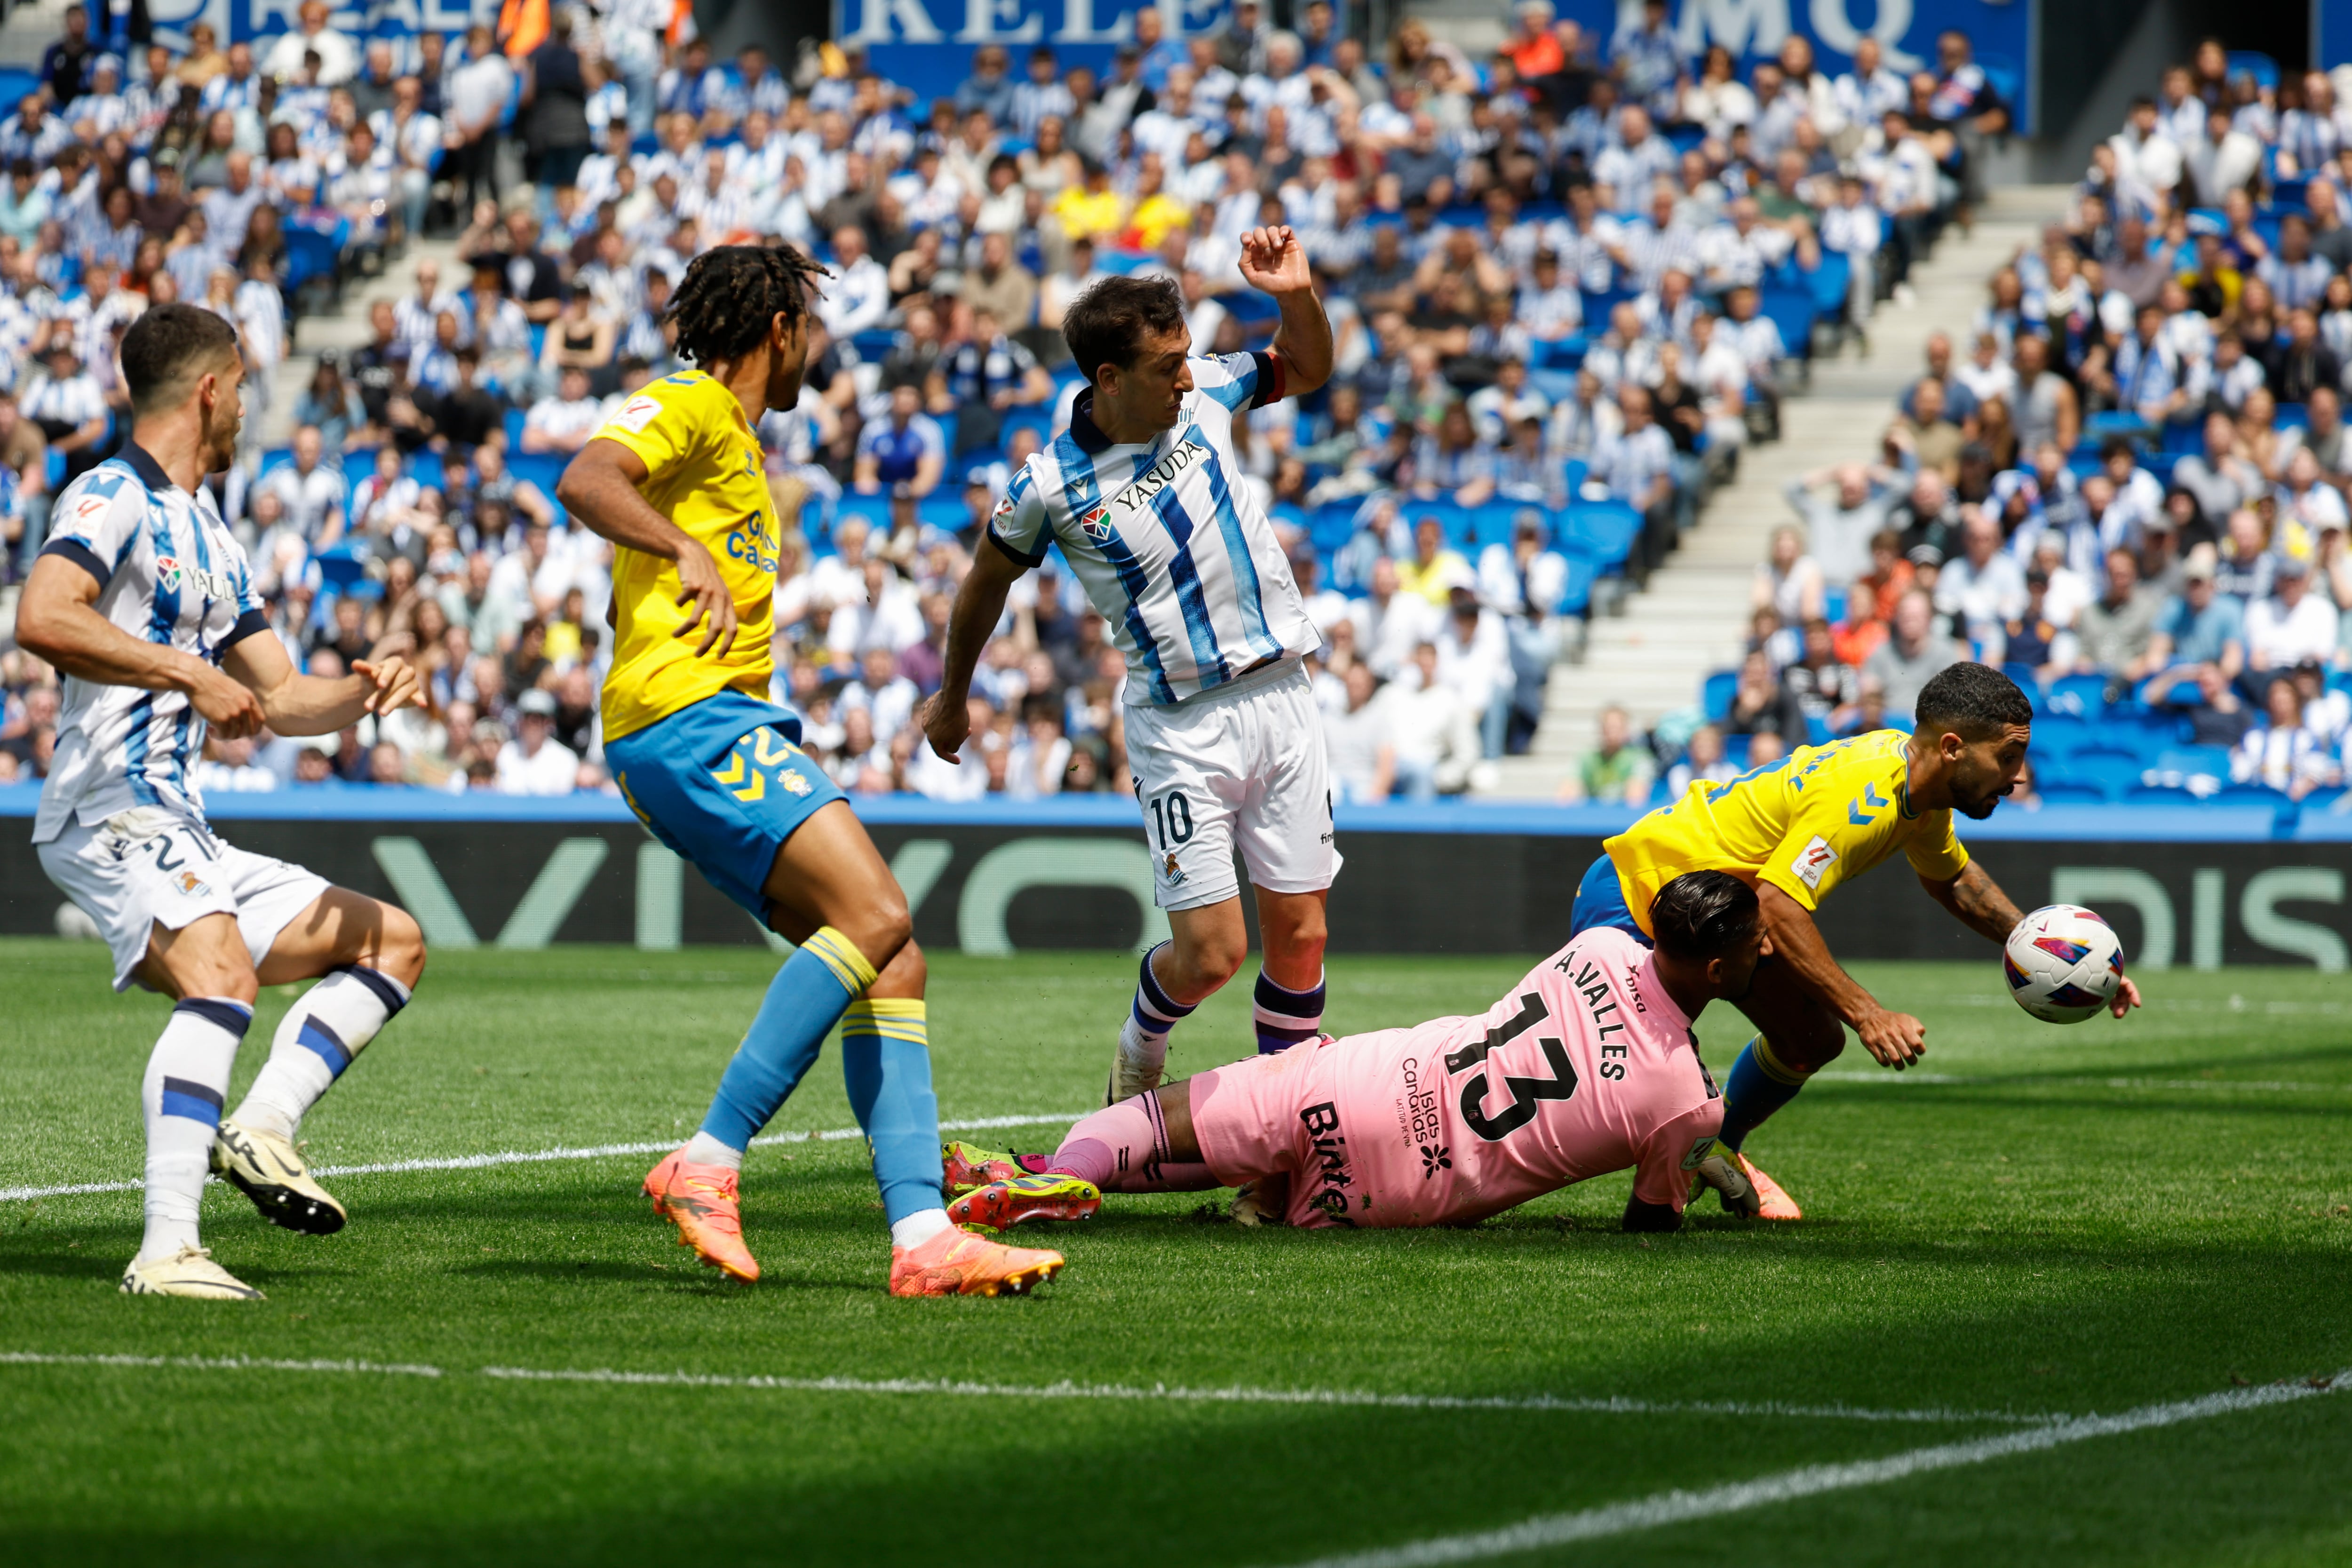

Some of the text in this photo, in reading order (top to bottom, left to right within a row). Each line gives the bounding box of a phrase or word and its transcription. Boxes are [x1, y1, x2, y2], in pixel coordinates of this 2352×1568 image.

[1115, 441, 1204, 512] YASUDA
[1194, 450, 1211, 469] group
[739, 725, 805, 766] 2
[1151, 791, 1193, 851] 10
[142, 827, 214, 872] 21
[1797, 862, 1818, 882] LALIGA
[1553, 944, 1627, 1081] Á.VALLES
[1444, 991, 1580, 1142] 13
[1402, 1058, 1428, 1143] Canarias
[1420, 1090, 1439, 1138] Islas
[1009, 1200, 1079, 1212] PREDATOR
